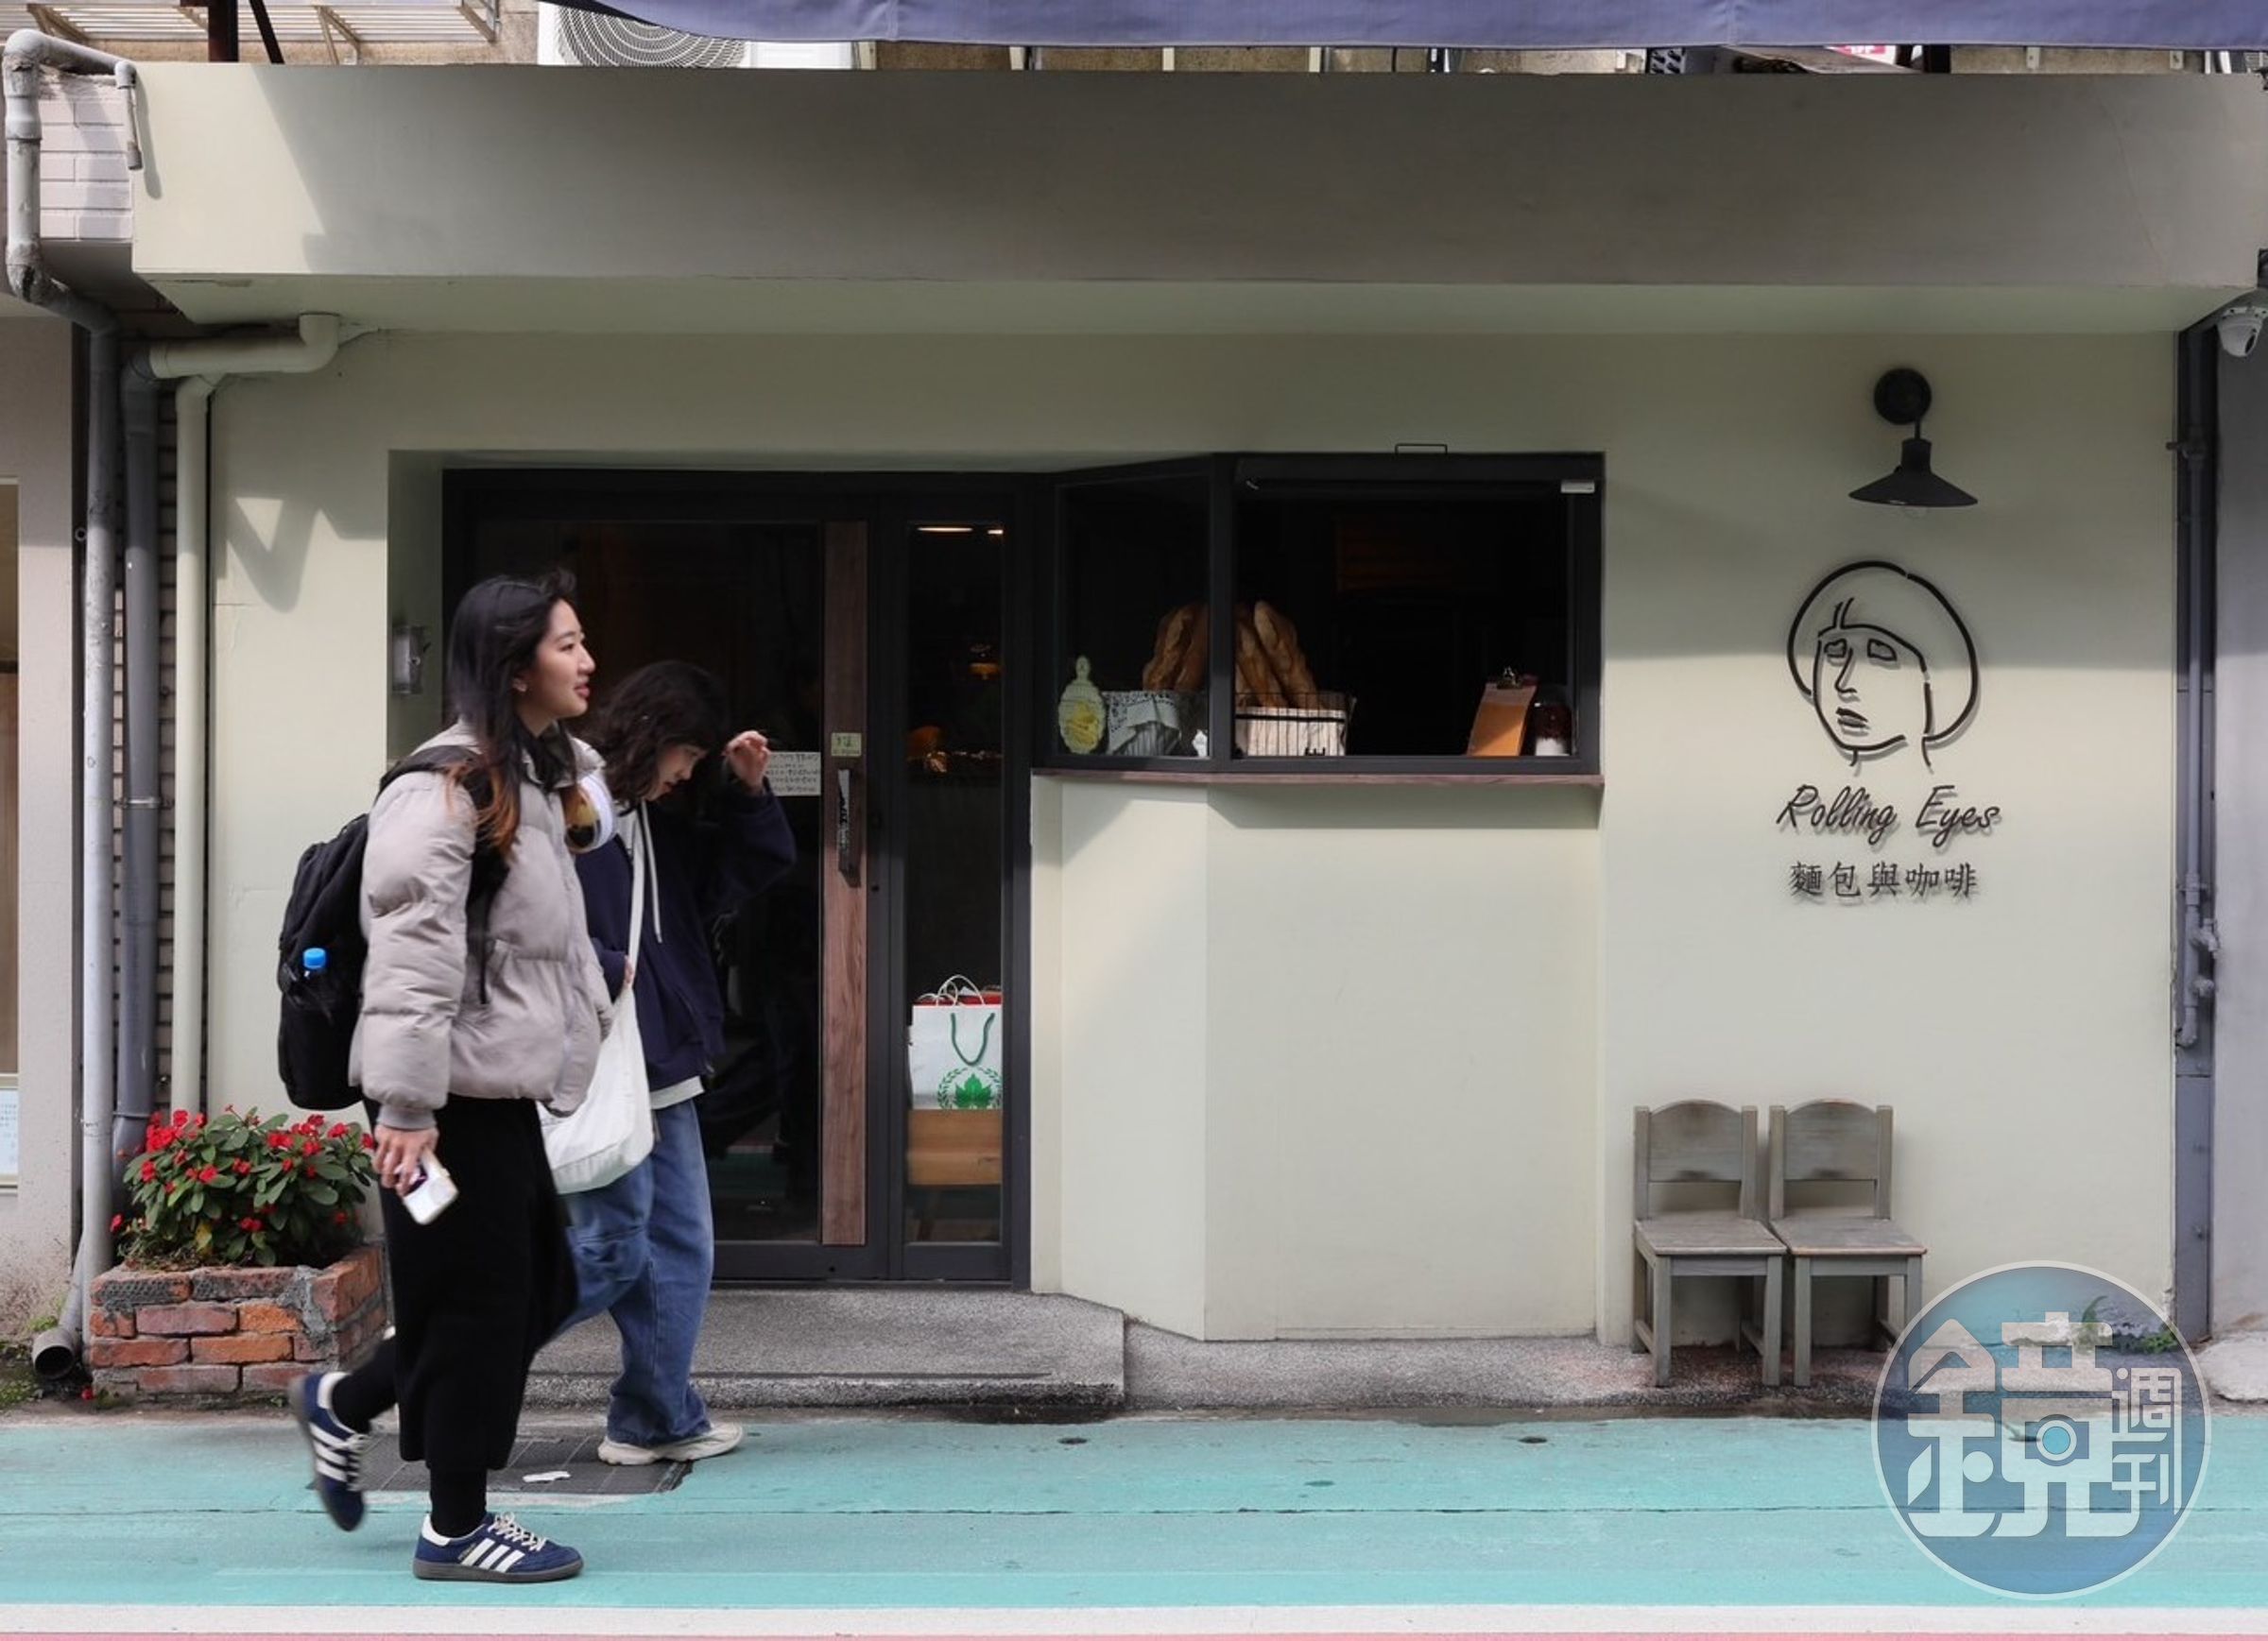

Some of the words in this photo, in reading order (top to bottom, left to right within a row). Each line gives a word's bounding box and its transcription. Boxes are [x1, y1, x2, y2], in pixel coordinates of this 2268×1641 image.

[1777, 784, 1898, 846] Rolling
[1916, 784, 2001, 847] Eyes
[1791, 861, 1977, 898] 麵包與咖啡
